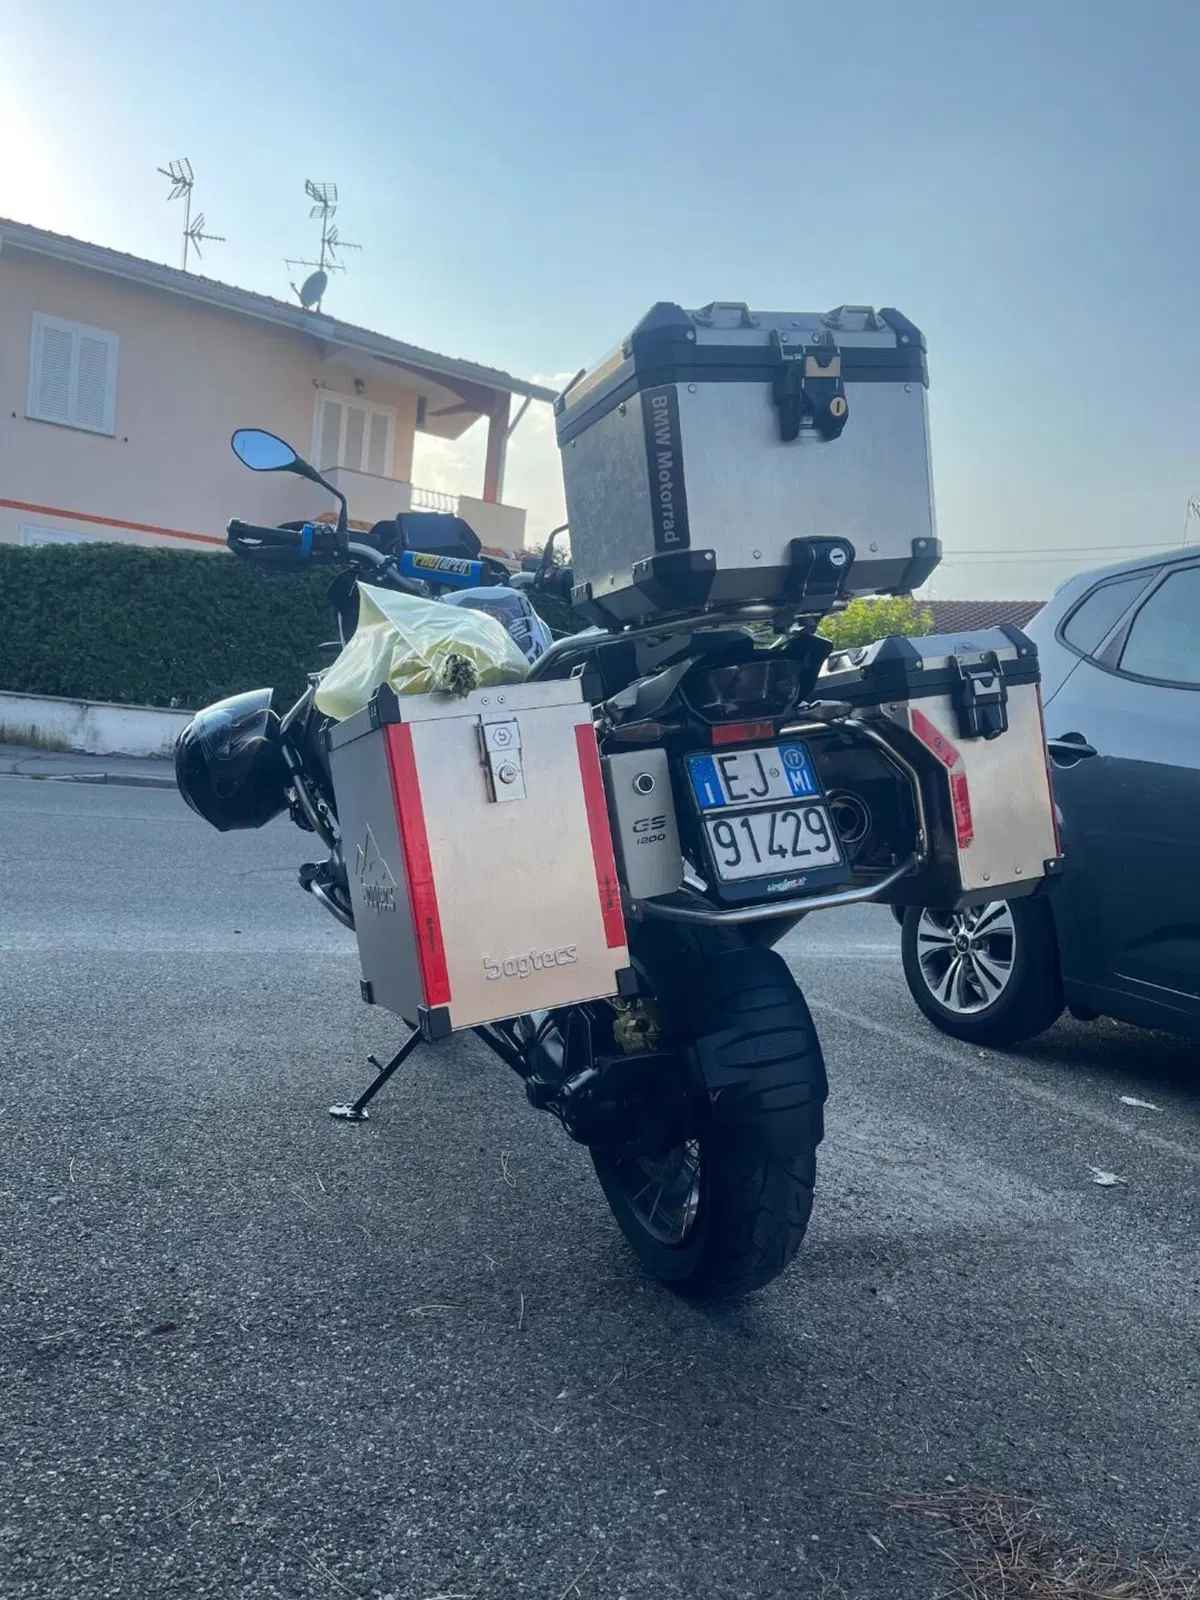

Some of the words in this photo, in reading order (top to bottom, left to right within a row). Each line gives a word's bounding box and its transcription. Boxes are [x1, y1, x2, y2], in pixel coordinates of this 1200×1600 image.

[651, 395, 672, 446] BMW
[656, 451, 680, 544] Motorrad
[717, 752, 770, 801] EJ
[788, 769, 812, 792] MI
[632, 814, 667, 833] GS
[636, 833, 666, 846] 1200
[712, 807, 832, 867] 91429
